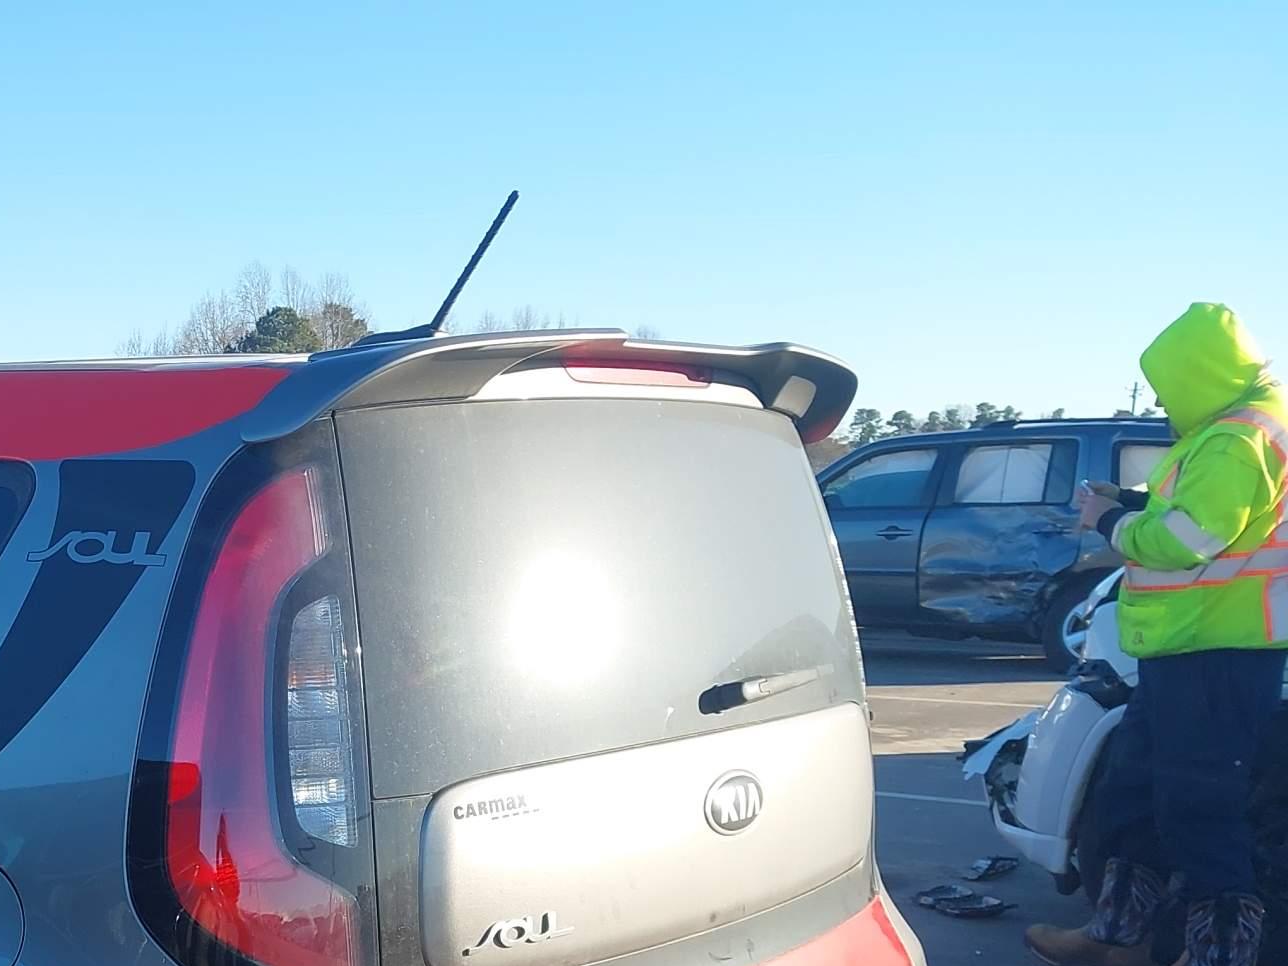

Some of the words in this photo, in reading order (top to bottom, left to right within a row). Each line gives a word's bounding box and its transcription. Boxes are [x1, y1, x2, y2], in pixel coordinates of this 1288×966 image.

[27, 530, 168, 567] SOUL
[718, 781, 760, 825] KIA
[461, 910, 576, 957] SOUL
